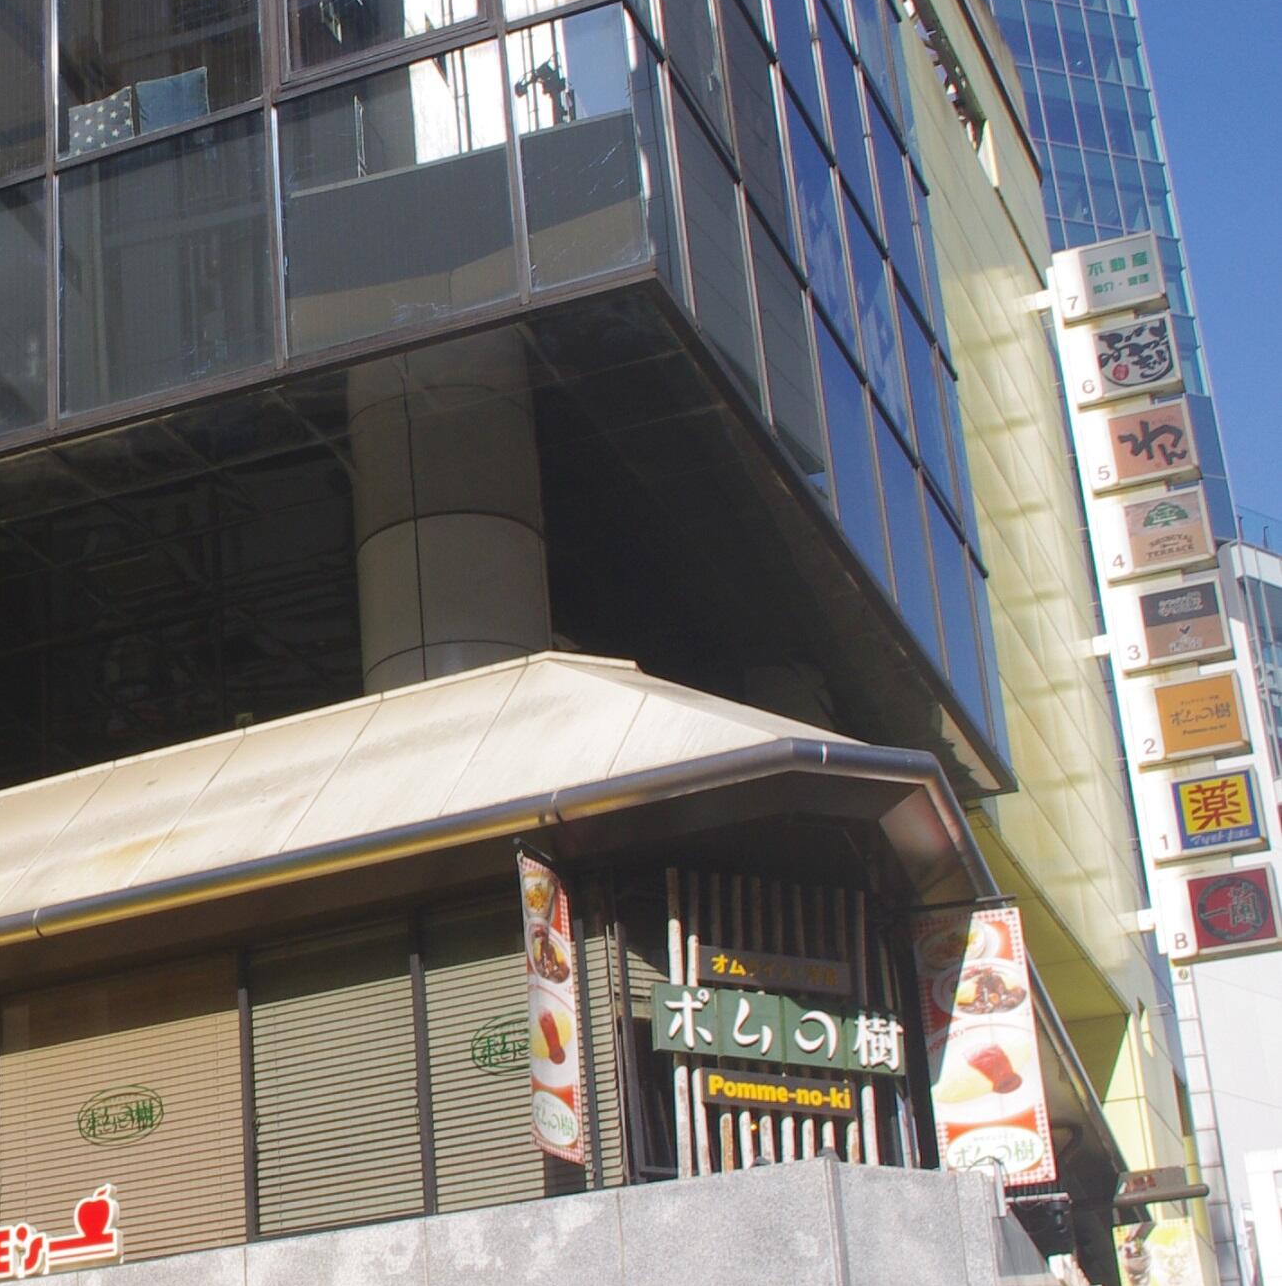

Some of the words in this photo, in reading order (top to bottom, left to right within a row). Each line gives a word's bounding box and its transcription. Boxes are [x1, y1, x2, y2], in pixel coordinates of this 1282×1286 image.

[1086, 251, 1150, 276] 不動産
[1068, 295, 1079, 312] 7
[1081, 379, 1096, 395] 6
[1118, 420, 1188, 466] わん
[1097, 464, 1111, 481] 5
[1112, 553, 1126, 570] 4
[1127, 644, 1141, 661] 3
[1143, 738, 1158, 755] 2
[1188, 779, 1244, 831] 薬
[1159, 834, 1169, 851] 1
[1173, 932, 1189, 952] B
[664, 988, 905, 1072] ポムの樹
[708, 1074, 852, 1110] Pomme-no-ki
